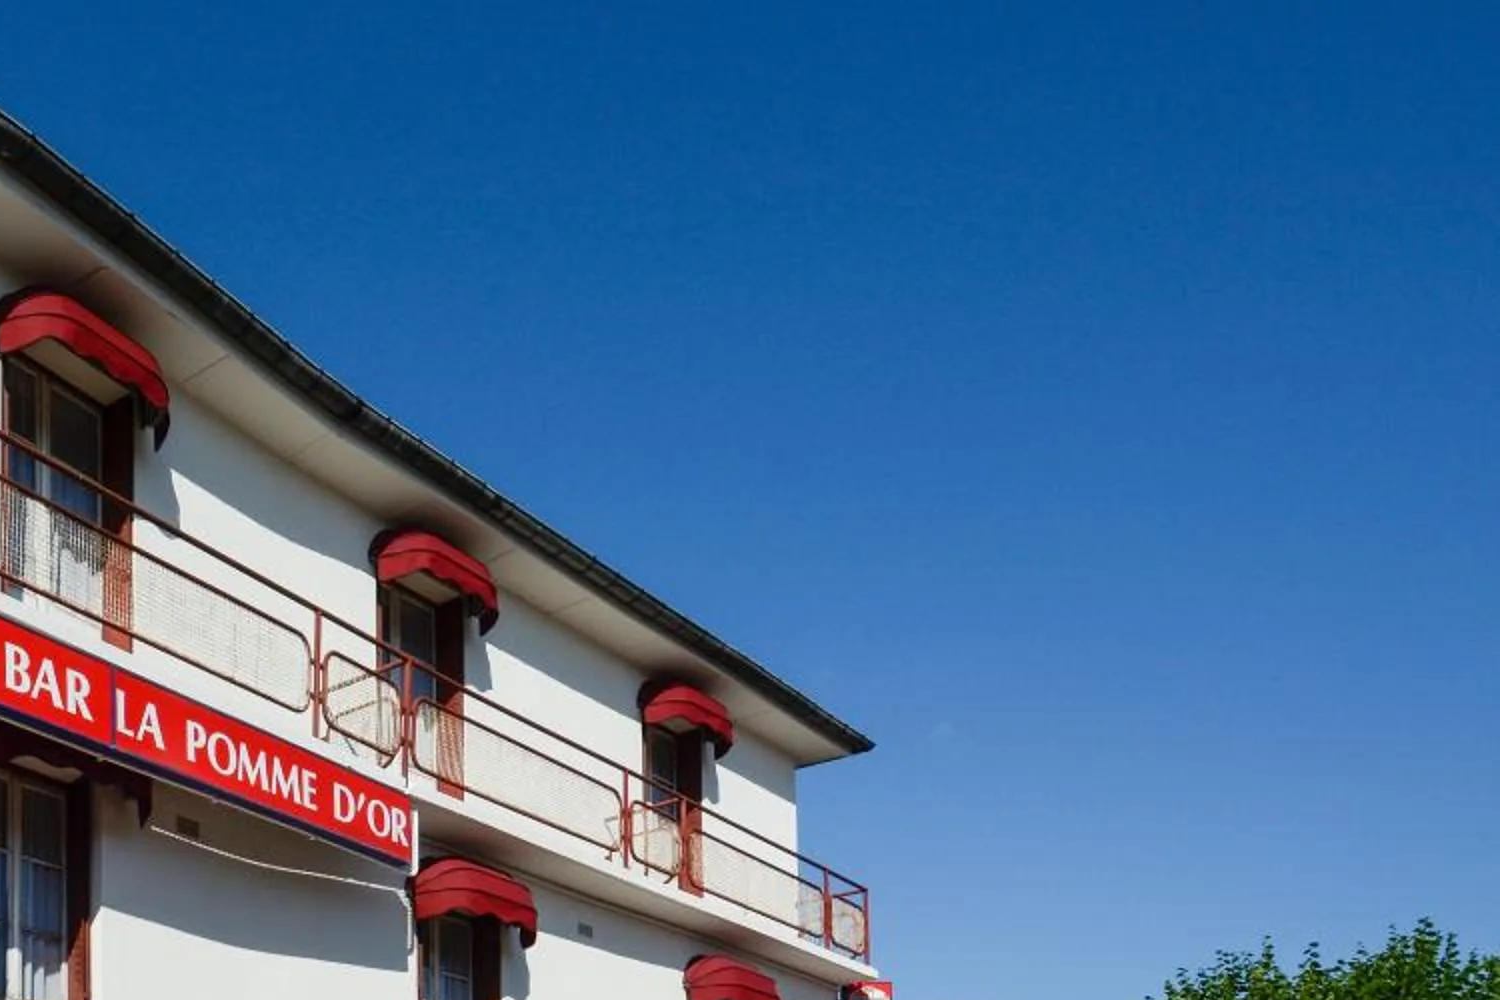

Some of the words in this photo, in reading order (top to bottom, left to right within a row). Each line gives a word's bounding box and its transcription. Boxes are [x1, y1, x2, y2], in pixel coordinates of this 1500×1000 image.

[5, 641, 93, 721] BAR
[115, 689, 165, 750] LA
[186, 719, 317, 811] POMME
[333, 782, 409, 847] D'OR
